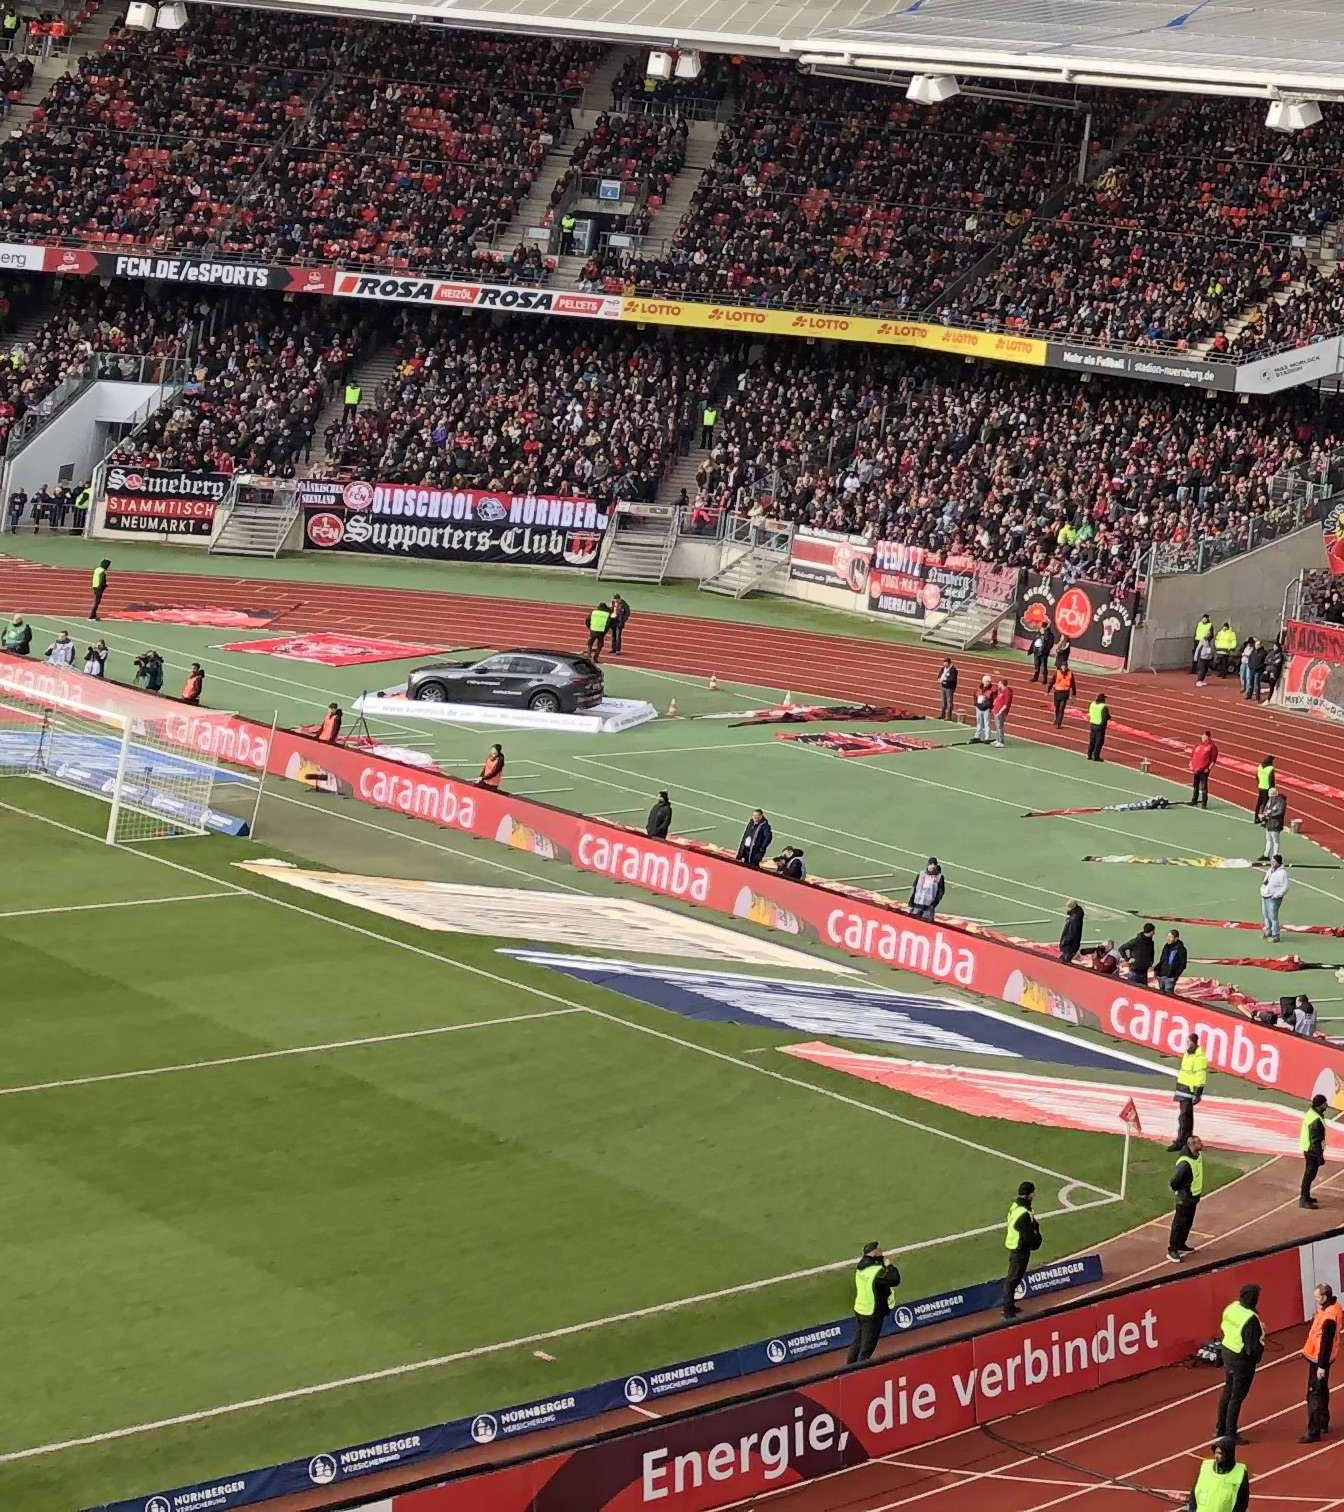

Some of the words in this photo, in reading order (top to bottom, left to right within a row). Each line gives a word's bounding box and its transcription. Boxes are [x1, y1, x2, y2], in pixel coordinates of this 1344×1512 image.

[115, 255, 269, 288] FCN.DE/eSPORTS
[356, 276, 434, 300] ROSA
[477, 288, 553, 310] ROSA
[558, 297, 599, 312] PELLETS
[640, 302, 682, 317] LOTTO
[725, 310, 766, 324] LOTTO
[808, 316, 850, 331] LOTTO
[893, 326, 928, 339] LOTTO
[951, 332, 979, 346] LOTTO
[1005, 339, 1033, 354] LOTTO
[109, 497, 217, 517] STAMMTISCH
[372, 487, 474, 521] OLDSCHOOL
[120, 515, 196, 533] NEUMARKT
[312, 525, 340, 540] FCN
[344, 514, 564, 556] Supporters-Club
[1058, 608, 1086, 627] FCN
[165, 711, 268, 767] caramba
[360, 765, 476, 829] caramba
[578, 832, 711, 902] caramba
[826, 908, 977, 986] caramba
[1109, 996, 1281, 1084] caramba
[650, 1360, 716, 1386] NÜRNBERGER
[501, 1396, 576, 1425] NÜRNBERGER
[642, 1404, 852, 1503] Energie,
[866, 1377, 936, 1435] die
[952, 1308, 1160, 1408] verbindet
[340, 1435, 421, 1465] NÜRNBERGER
[174, 1479, 246, 1507] NÜRNBERGER
